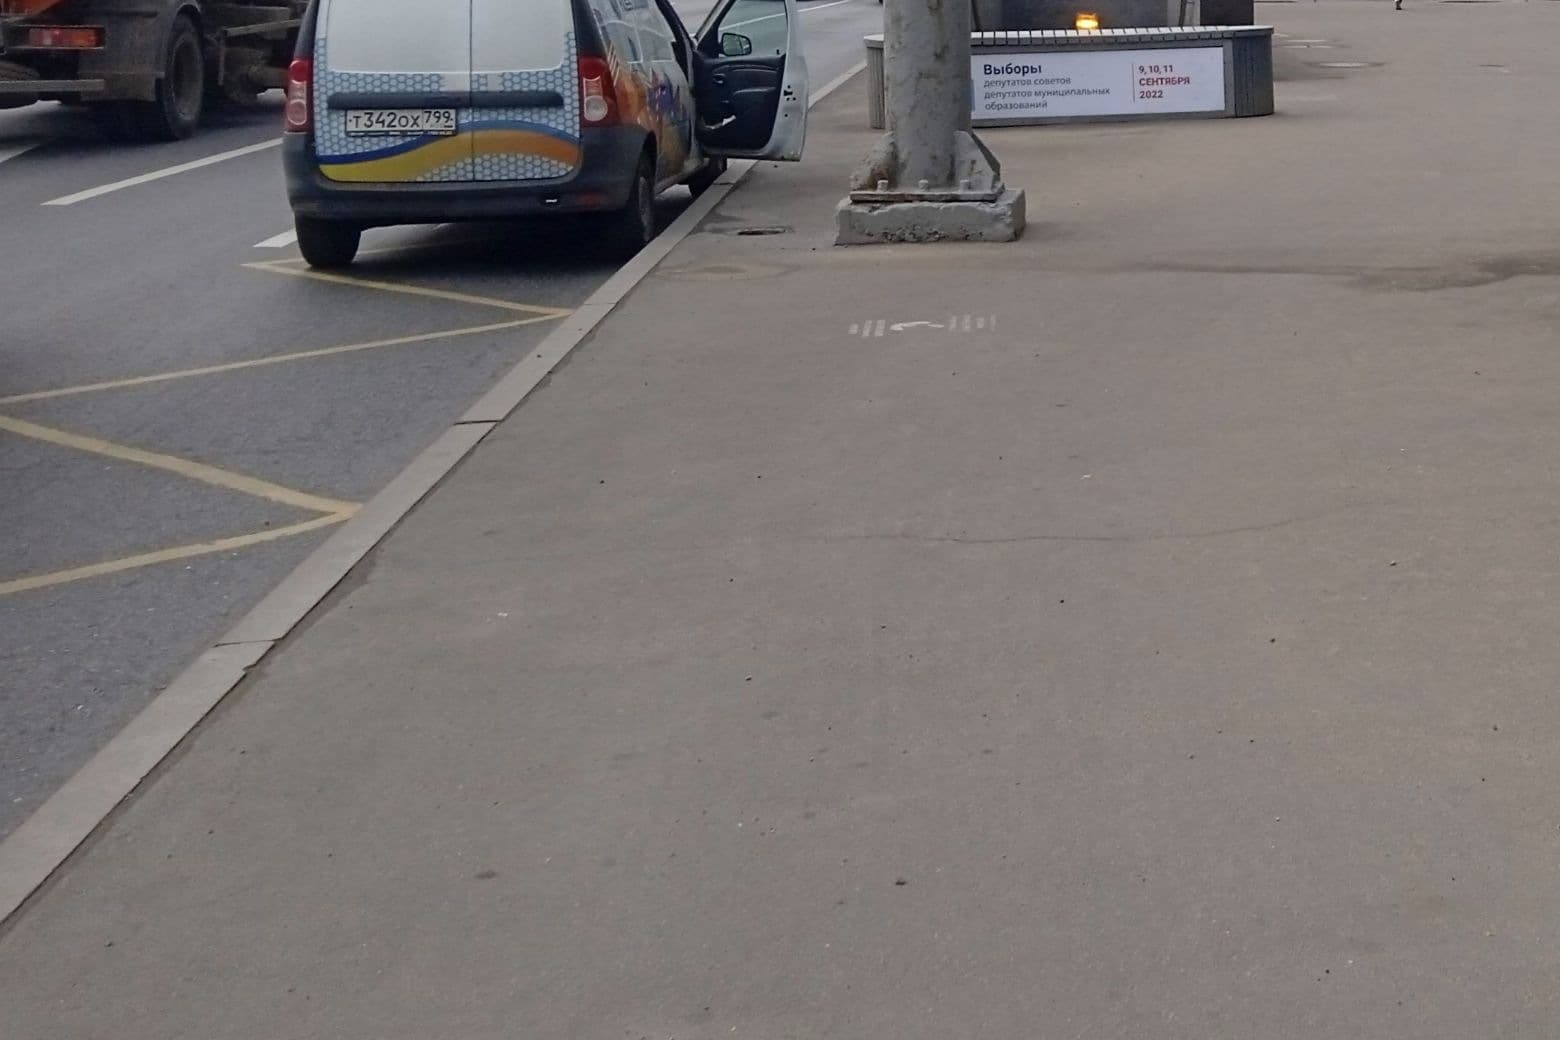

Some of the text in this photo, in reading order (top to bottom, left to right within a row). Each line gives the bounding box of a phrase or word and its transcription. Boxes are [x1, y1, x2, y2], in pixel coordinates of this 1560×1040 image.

[983, 64, 1042, 77] Выборы
[983, 76, 1071, 88] депутатов советов
[1139, 76, 1190, 86] СЕНТЯБРЯ
[984, 87, 1111, 100] депутатов муниципальных
[1139, 90, 1164, 99] 2022
[985, 100, 1048, 111] образований
[424, 110, 451, 123] 799
